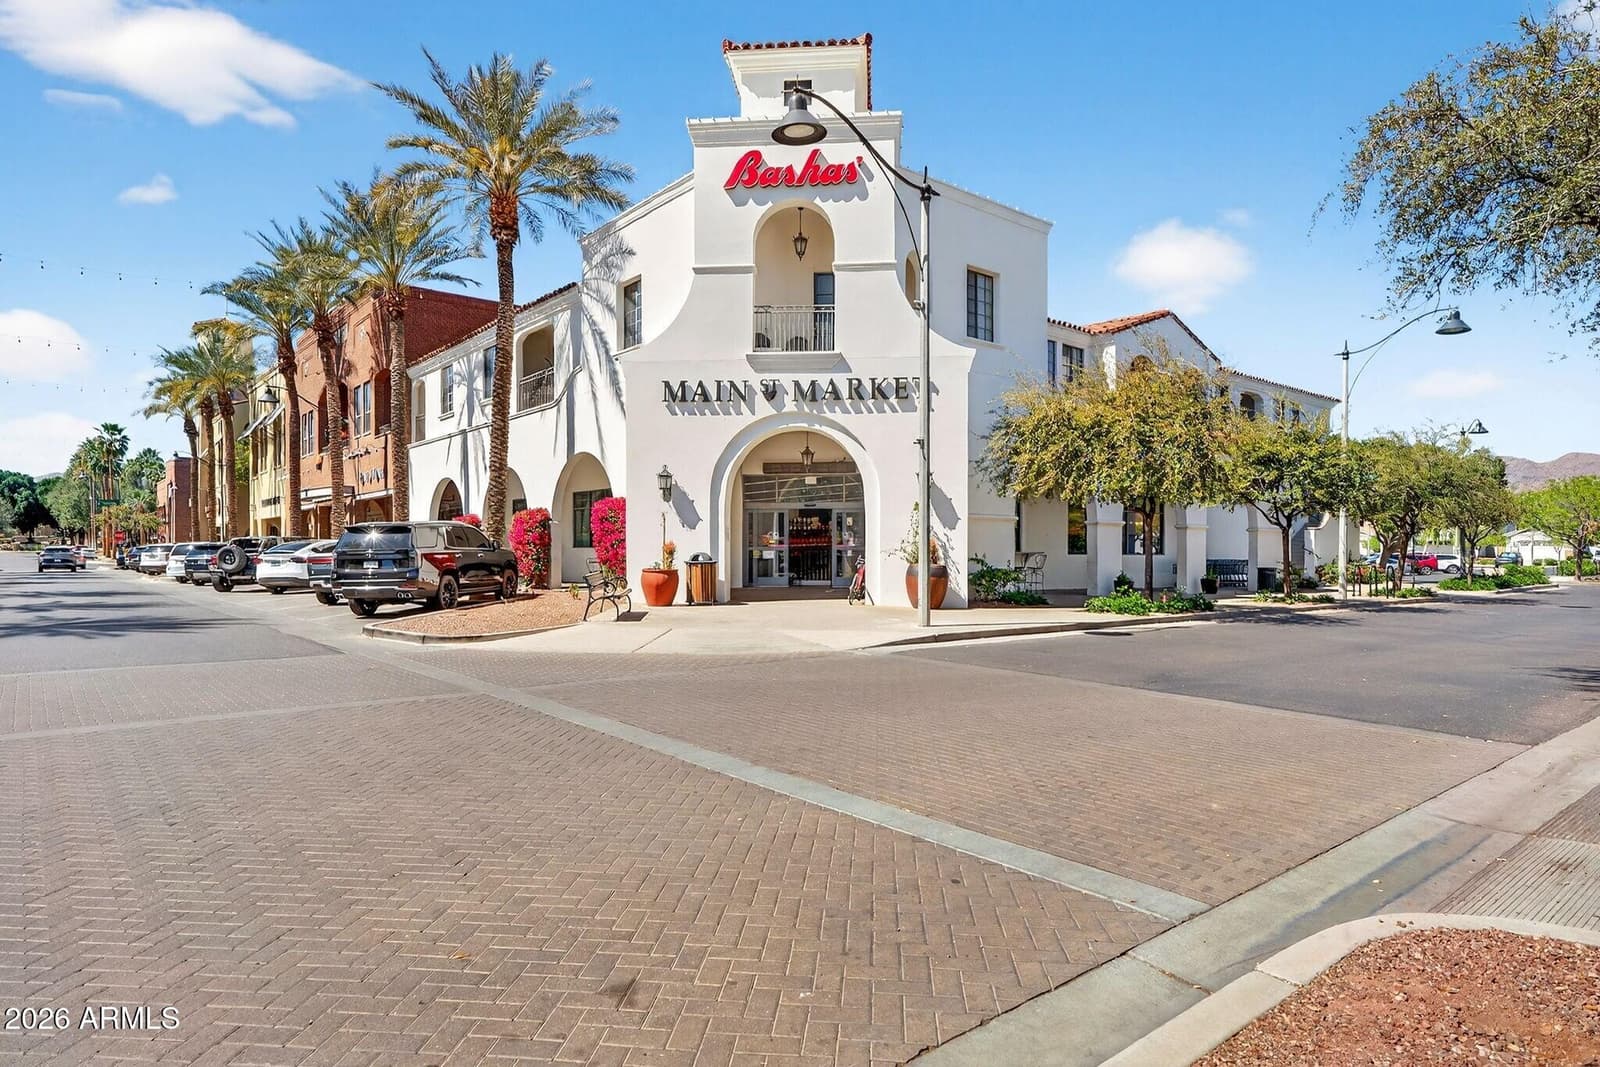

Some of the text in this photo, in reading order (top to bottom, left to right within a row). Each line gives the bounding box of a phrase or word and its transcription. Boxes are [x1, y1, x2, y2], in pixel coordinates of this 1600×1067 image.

[723, 149, 863, 190] Bashas'
[661, 380, 749, 403] MAIN
[760, 378, 780, 394] ST
